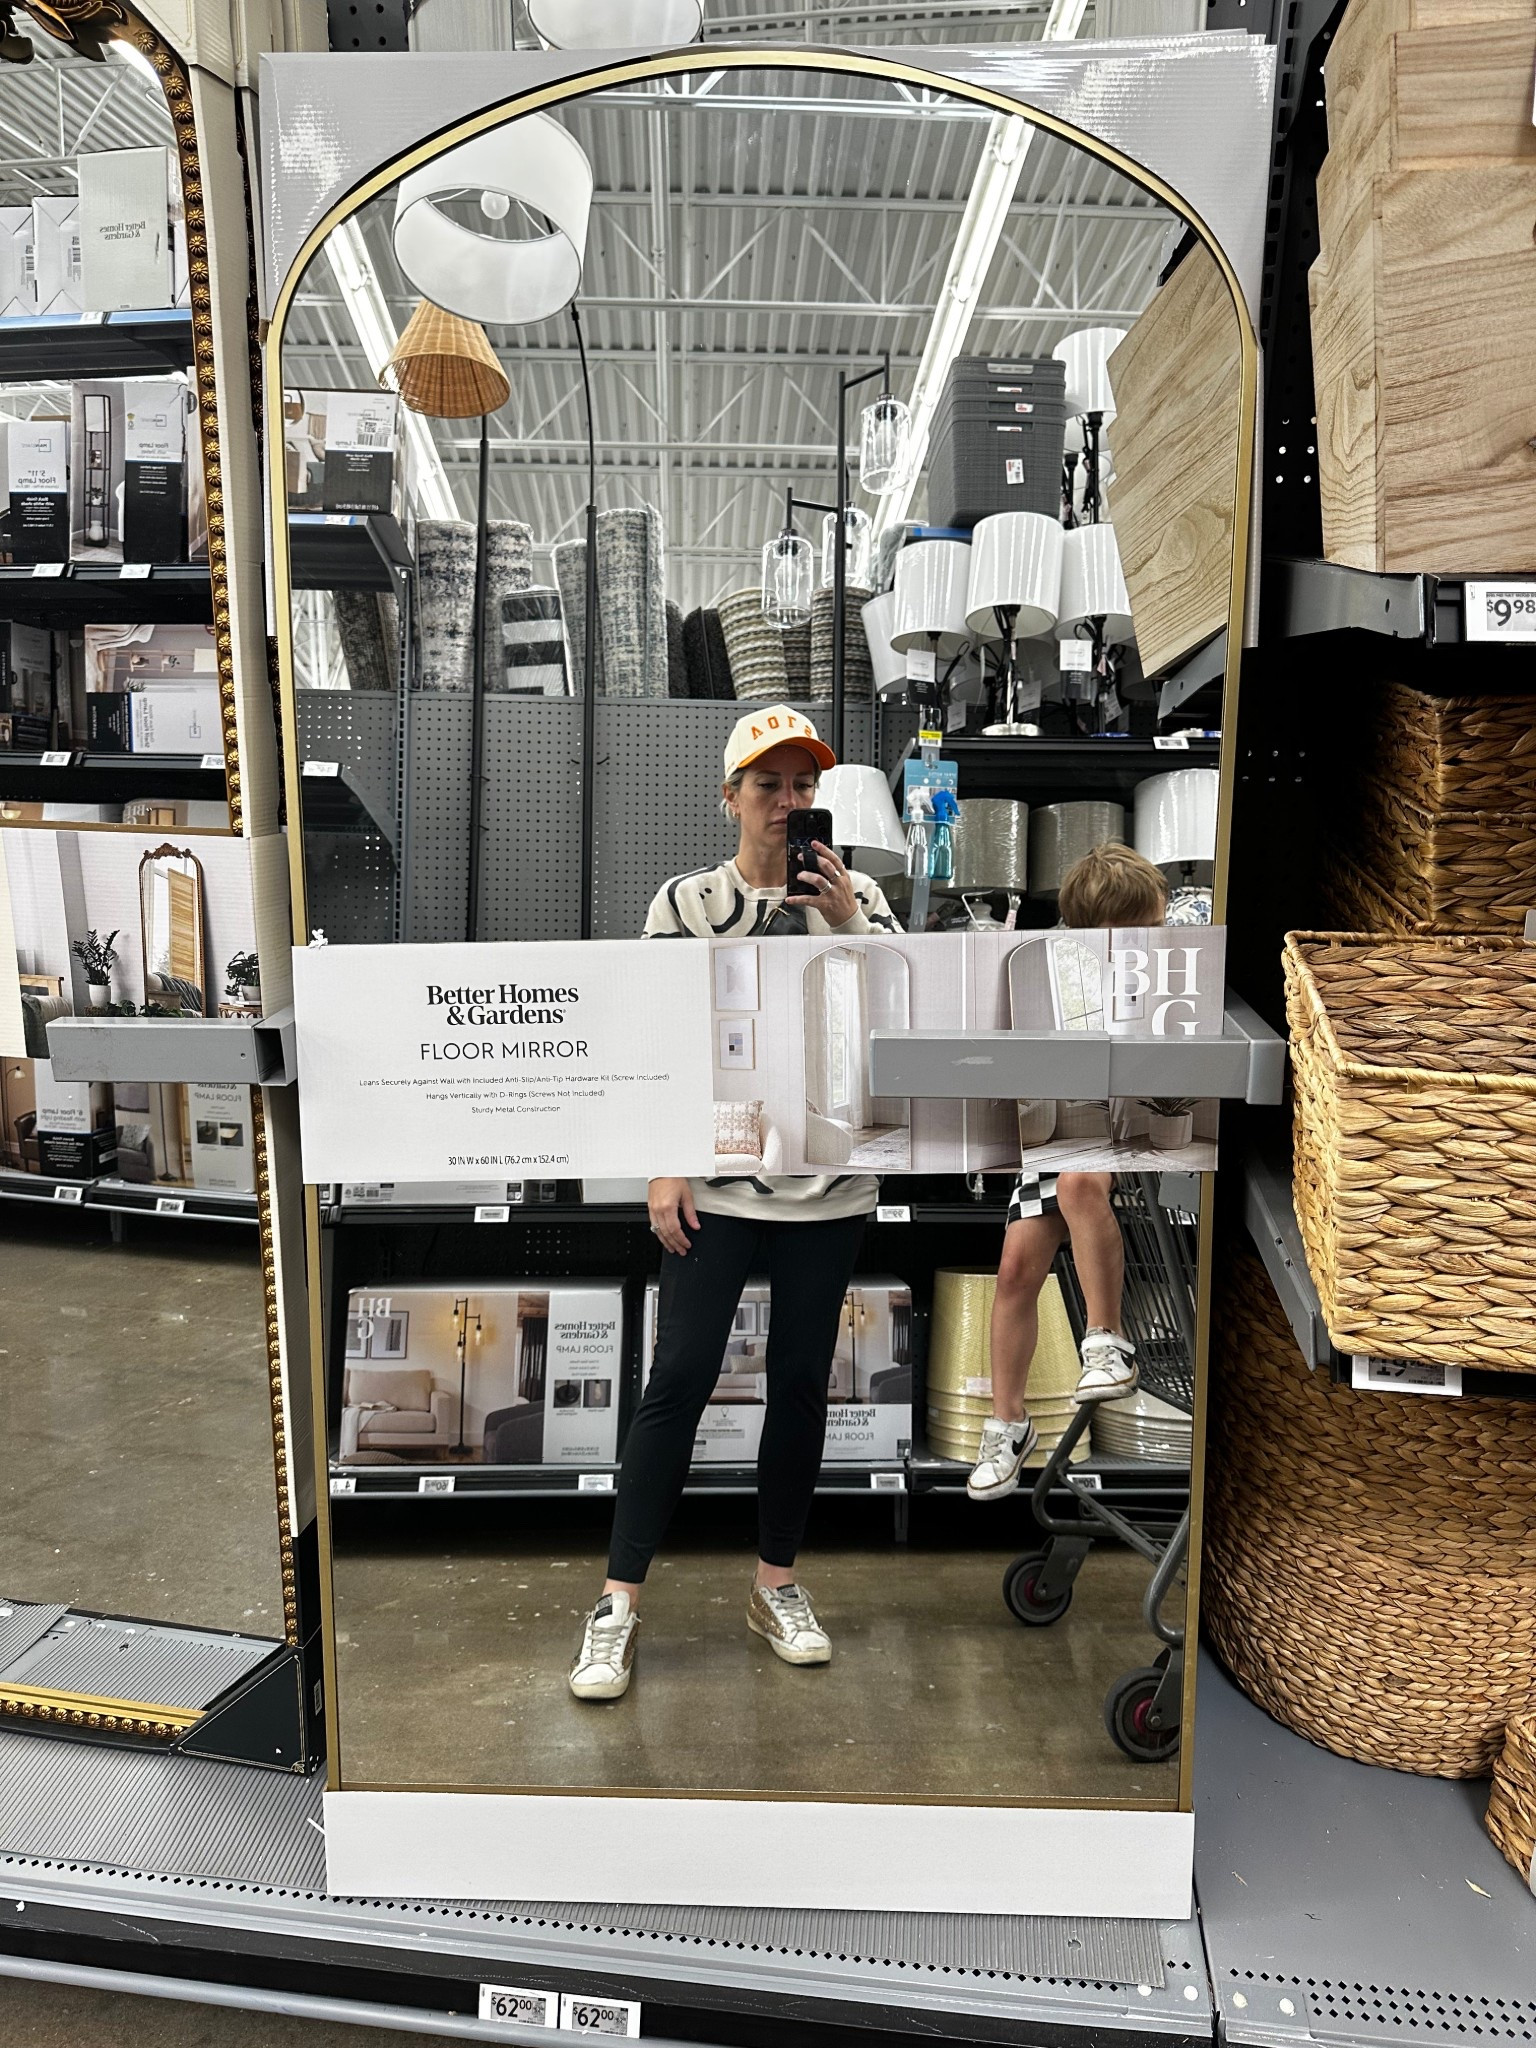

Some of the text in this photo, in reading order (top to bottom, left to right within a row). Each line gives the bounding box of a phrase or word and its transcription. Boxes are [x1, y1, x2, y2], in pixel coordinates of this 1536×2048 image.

[1110, 947, 1202, 997] BH
[426, 984, 579, 1005] Better Homes
[446, 1005, 564, 1025] & Gardens
[1151, 999, 1201, 1035] G
[420, 1040, 588, 1060] FLOOR MIRROR
[381, 1078, 411, 1087] Securely
[412, 1078, 439, 1086] Against
[611, 1074, 635, 1082] (Screw
[636, 1073, 670, 1081] Included)
[426, 1093, 448, 1101] Hangs
[450, 1092, 482, 1100] Vertically
[499, 1091, 528, 1100] D-Rings
[528, 1090, 556, 1099] (Screws
[572, 1090, 605, 1098] Included)
[472, 1106, 494, 1114] Sturdy
[448, 1156, 457, 1166] 30
[458, 1156, 466, 1165] IN
[466, 1156, 474, 1165] W
[480, 1156, 489, 1165] 60
[490, 1156, 498, 1164] IN
[499, 1156, 503, 1164] L
[504, 1155, 521, 1165] (76.2
[538, 1154, 555, 1164] 152.4
[556, 1154, 570, 1165] cm)
